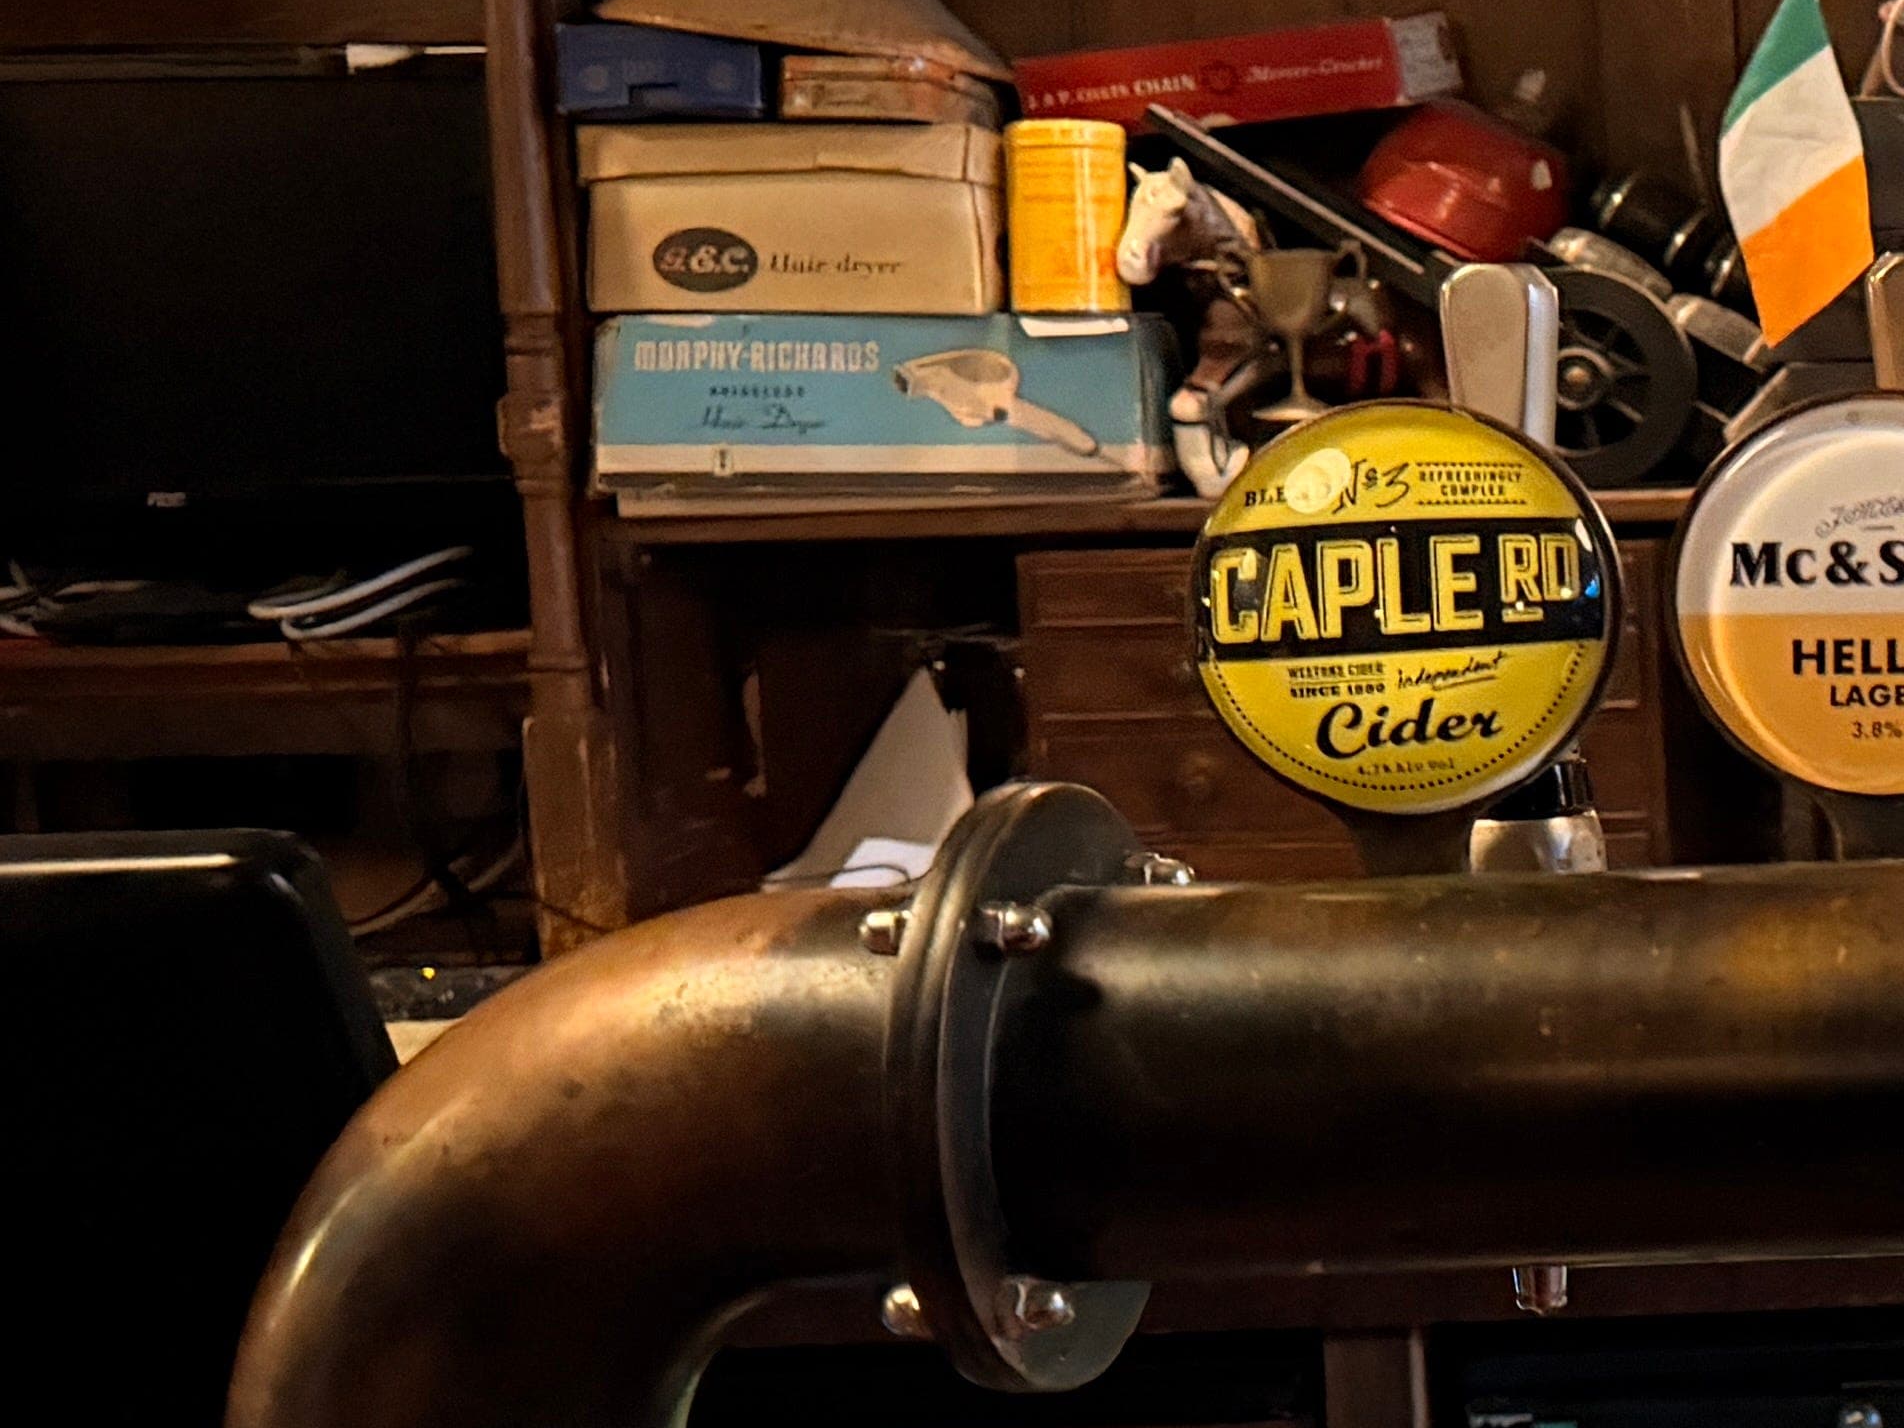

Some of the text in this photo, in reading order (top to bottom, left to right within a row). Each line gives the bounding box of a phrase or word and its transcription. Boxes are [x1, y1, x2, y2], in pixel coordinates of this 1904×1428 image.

[1133, 73, 1197, 97] CHAIN
[770, 252, 828, 274] Hair
[834, 252, 902, 279] dryer
[634, 340, 880, 373] MORPHY-RICHARDS
[1210, 532, 1582, 645] CAPLE RD
[1289, 685, 1341, 699] SINCE
[1315, 697, 1503, 760] Cider
[1851, 721, 1904, 740] 3.8%
